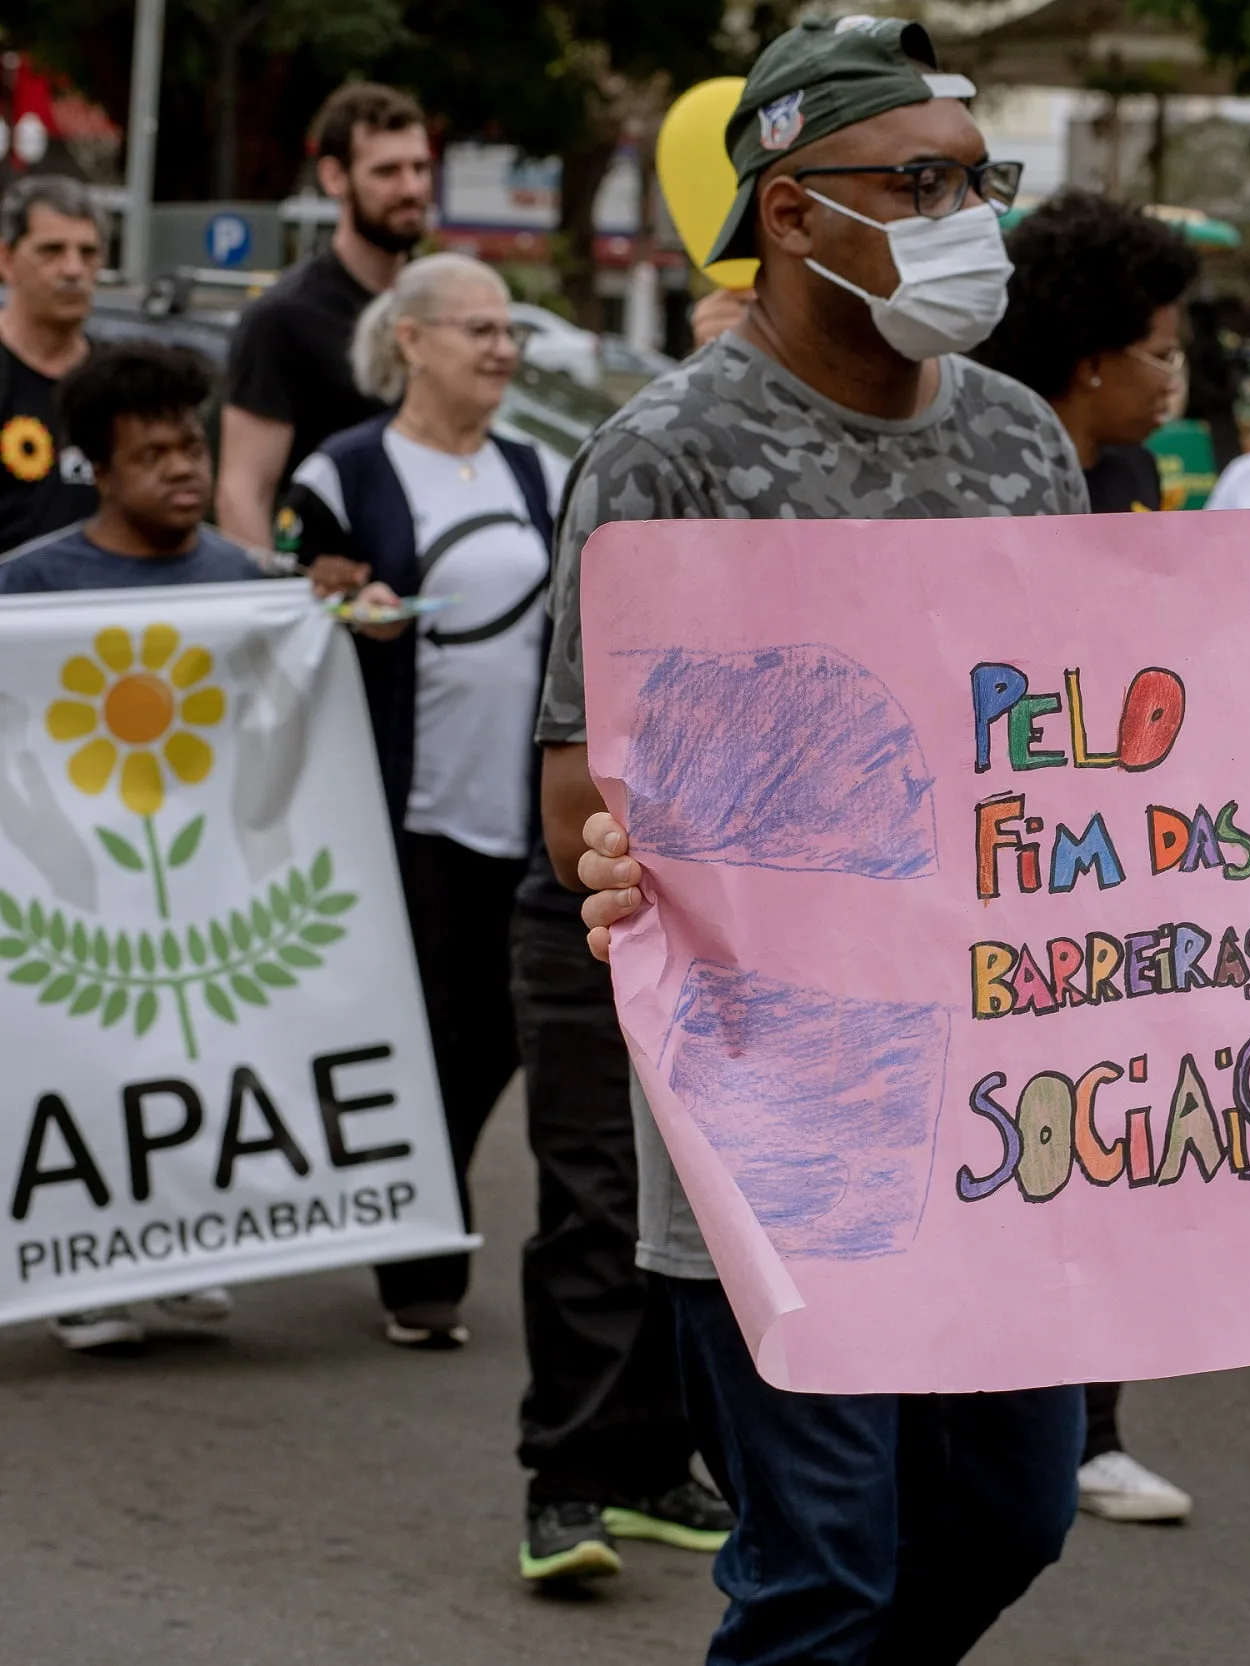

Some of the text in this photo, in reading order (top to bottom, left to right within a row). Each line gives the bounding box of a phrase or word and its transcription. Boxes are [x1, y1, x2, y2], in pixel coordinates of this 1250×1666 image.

[213, 216, 246, 261] P
[971, 662, 1186, 773] PELO
[11, 1043, 415, 1222] APAE
[18, 1181, 417, 1282] PIRACICABA/SP
